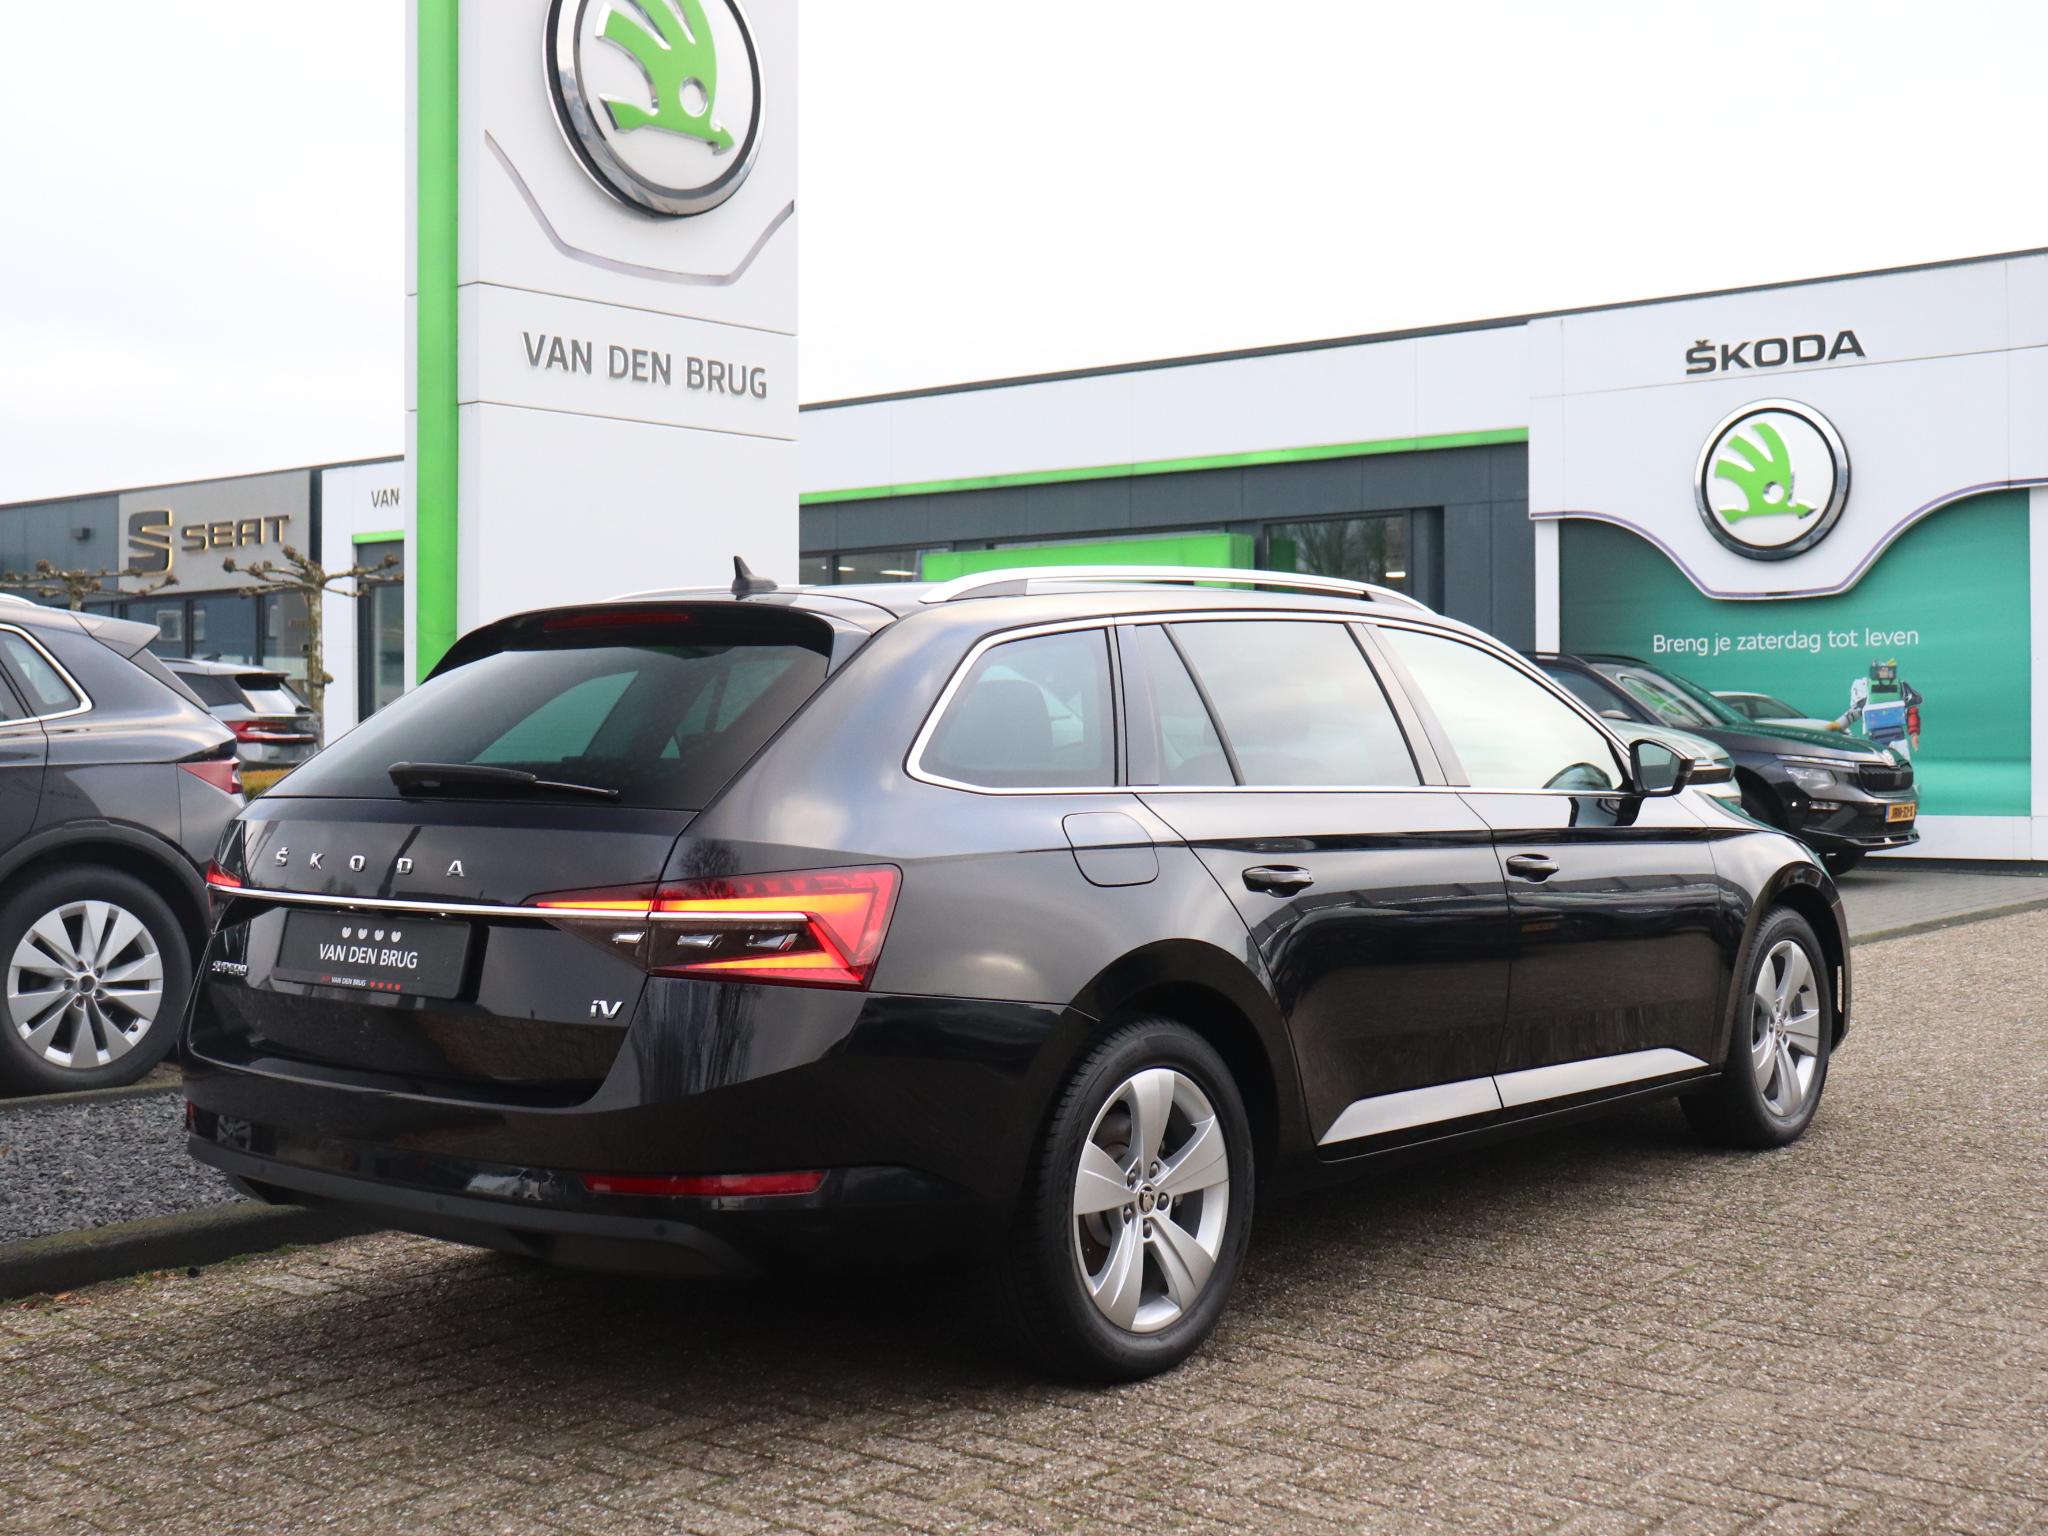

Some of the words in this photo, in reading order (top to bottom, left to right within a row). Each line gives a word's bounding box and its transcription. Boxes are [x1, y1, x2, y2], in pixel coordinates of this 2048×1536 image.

[523, 331, 592, 374] VAN
[608, 344, 671, 386] DEN
[686, 356, 767, 399] BRUG
[1685, 329, 1866, 375] ŠKODA
[371, 488, 400, 508] VAN
[181, 514, 291, 551] SEAT
[1653, 634, 1708, 656] Breng
[1713, 633, 1731, 656] je
[1737, 630, 1821, 653] zaterdag
[1828, 629, 1858, 648] tot
[1865, 627, 1919, 646] leven
[320, 944, 346, 962] VAN
[348, 946, 377, 965] DEN
[379, 949, 418, 969] BRUG
[331, 976, 342, 984] VAN
[342, 977, 353, 985] DEN
